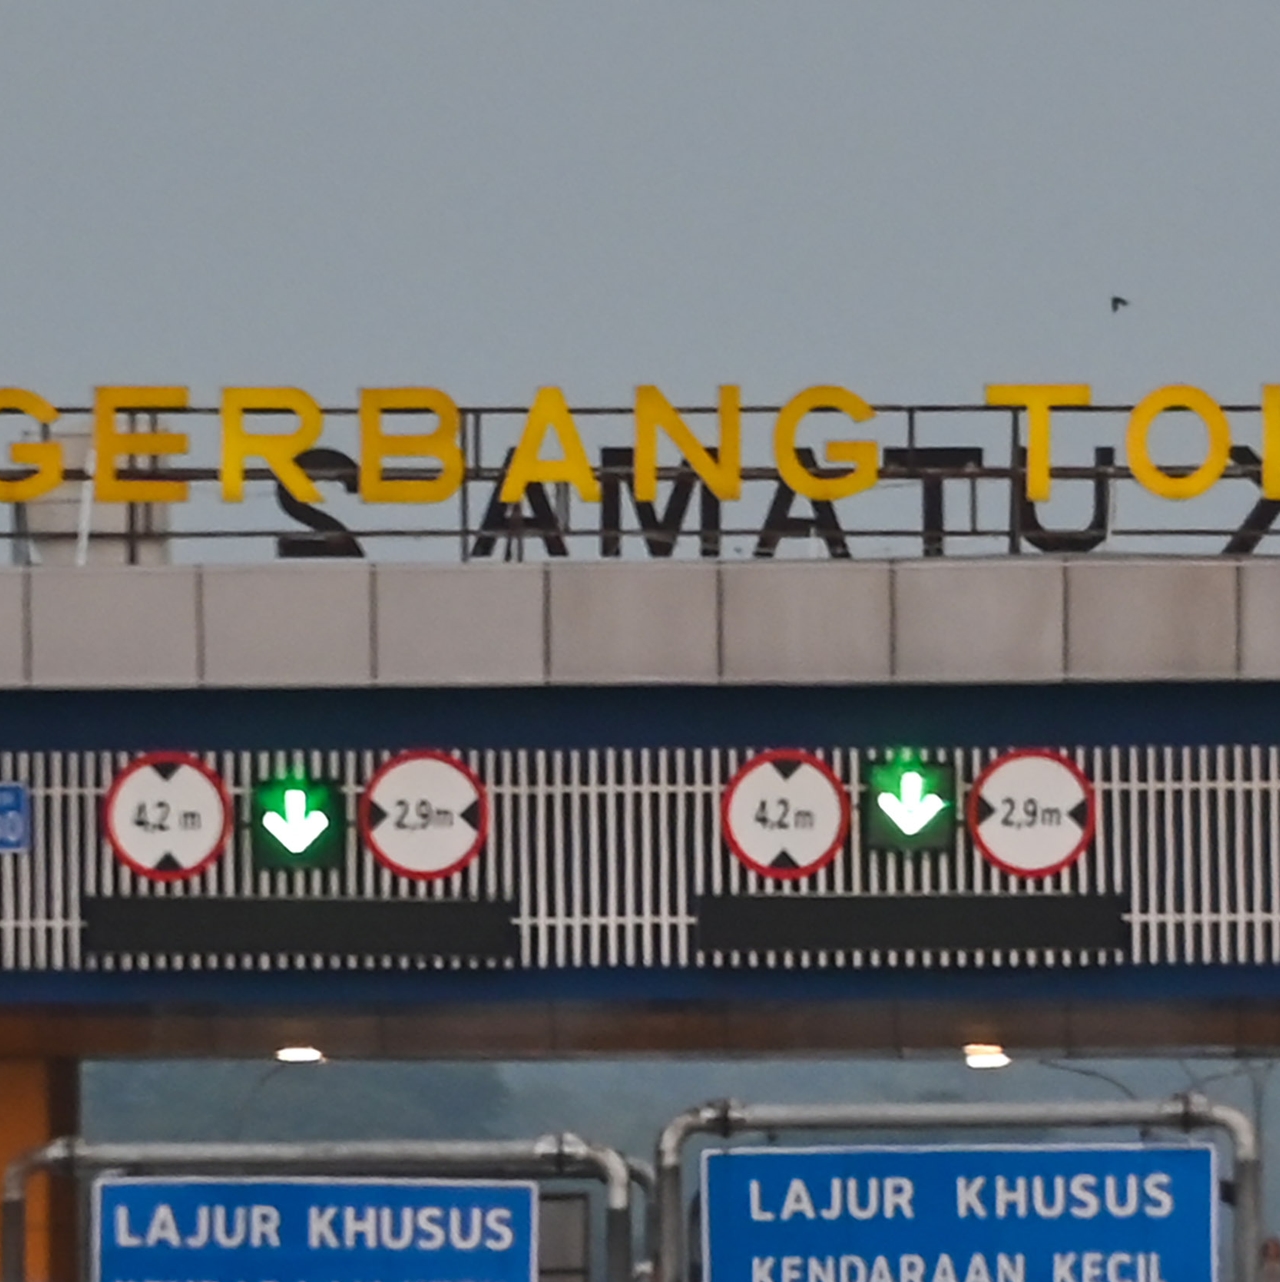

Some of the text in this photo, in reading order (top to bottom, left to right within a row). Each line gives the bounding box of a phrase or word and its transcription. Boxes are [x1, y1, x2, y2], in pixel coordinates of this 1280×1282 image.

[748, 1172, 1174, 1221] LAJUR KHUSUS
[114, 1203, 514, 1251] LAJUR KHUSUS
